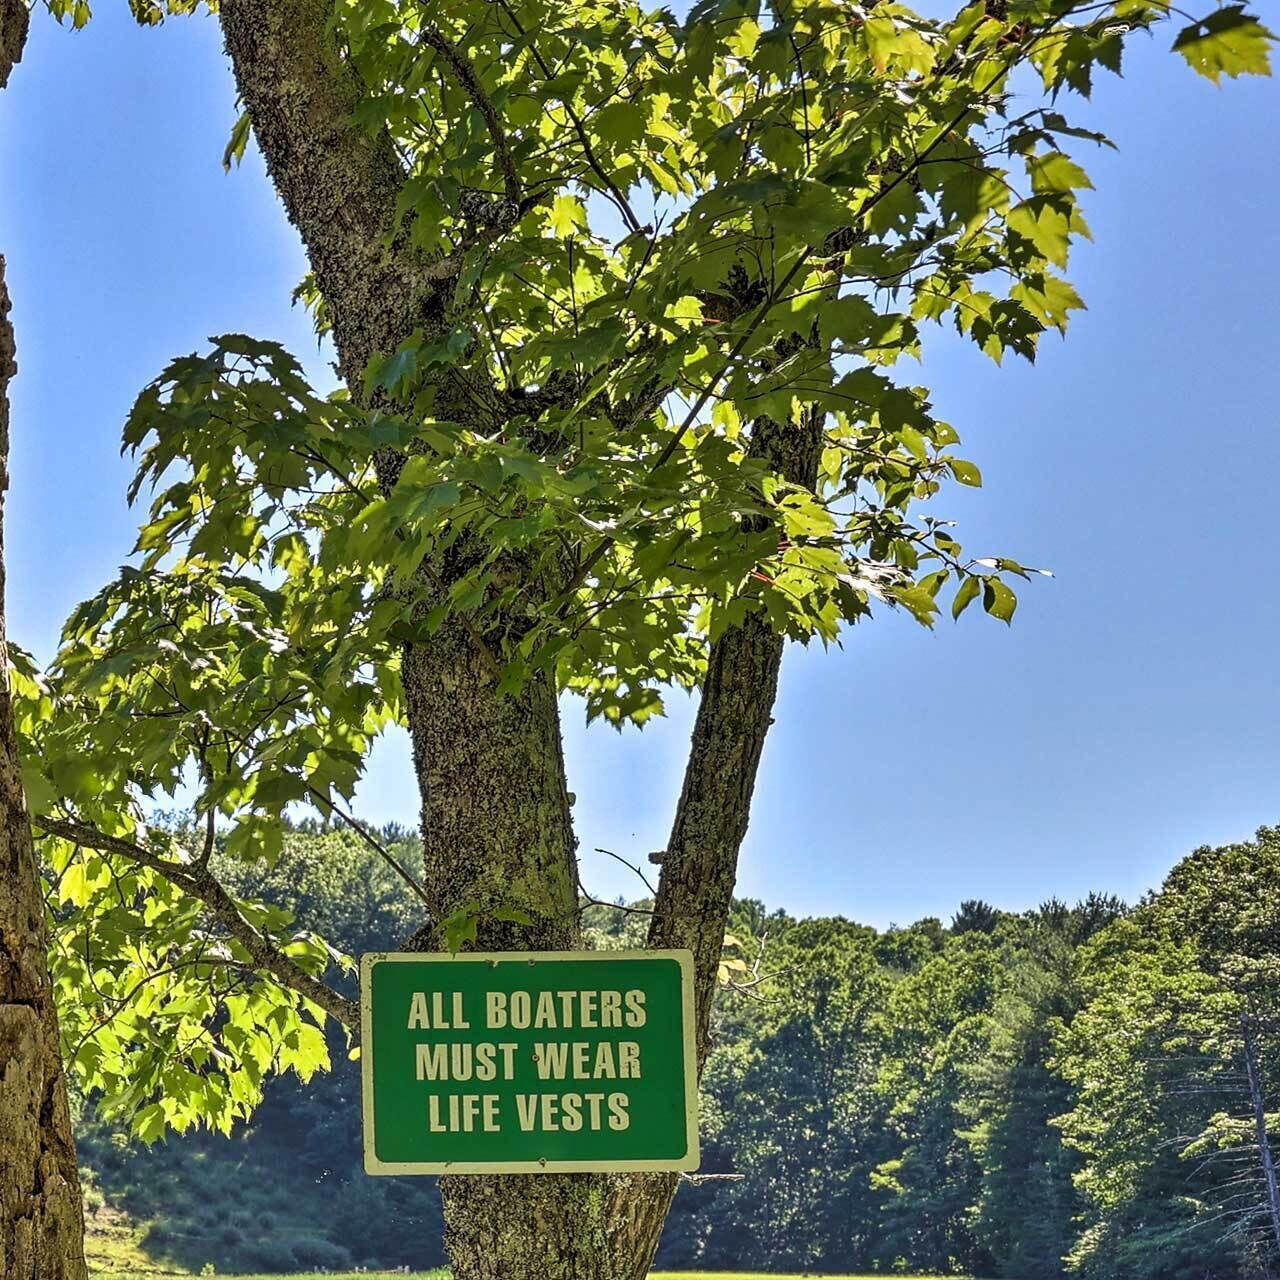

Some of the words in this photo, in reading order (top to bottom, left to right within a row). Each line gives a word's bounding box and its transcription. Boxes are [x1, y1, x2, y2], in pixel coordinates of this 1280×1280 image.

[407, 991, 470, 1030] ALL
[485, 989, 647, 1029] BOATERS
[415, 1043, 519, 1081] MUST
[534, 1041, 642, 1079] WEAR
[429, 1094, 501, 1132] LIFE
[516, 1092, 630, 1131] VESTS
